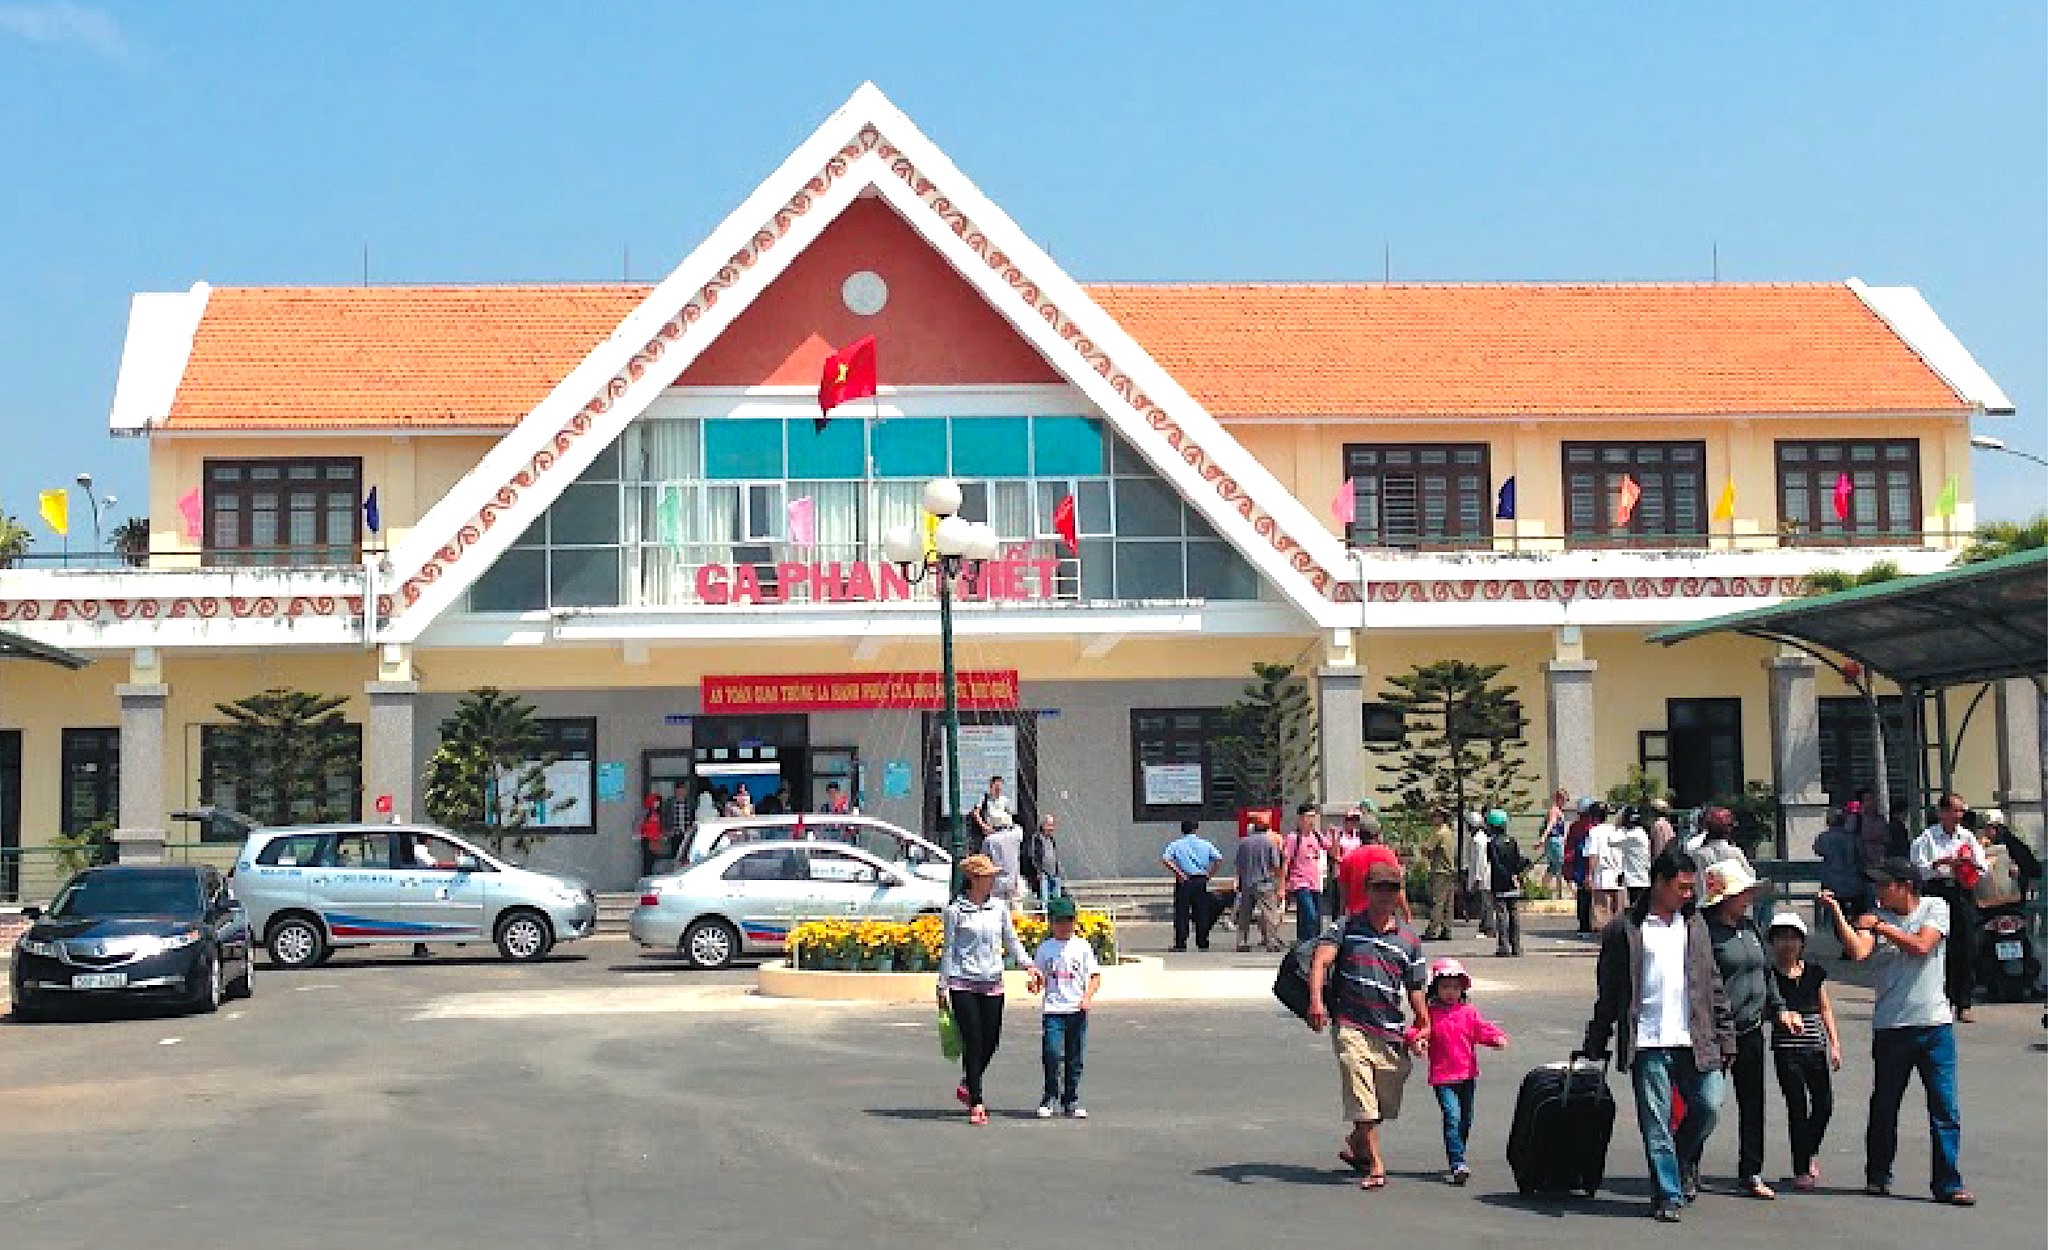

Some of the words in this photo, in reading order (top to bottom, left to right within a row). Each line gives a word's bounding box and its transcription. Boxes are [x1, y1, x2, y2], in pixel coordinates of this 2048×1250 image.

[695, 561, 762, 604] GA
[777, 560, 910, 601] PHAN
[927, 543, 1061, 600] HIẾT
